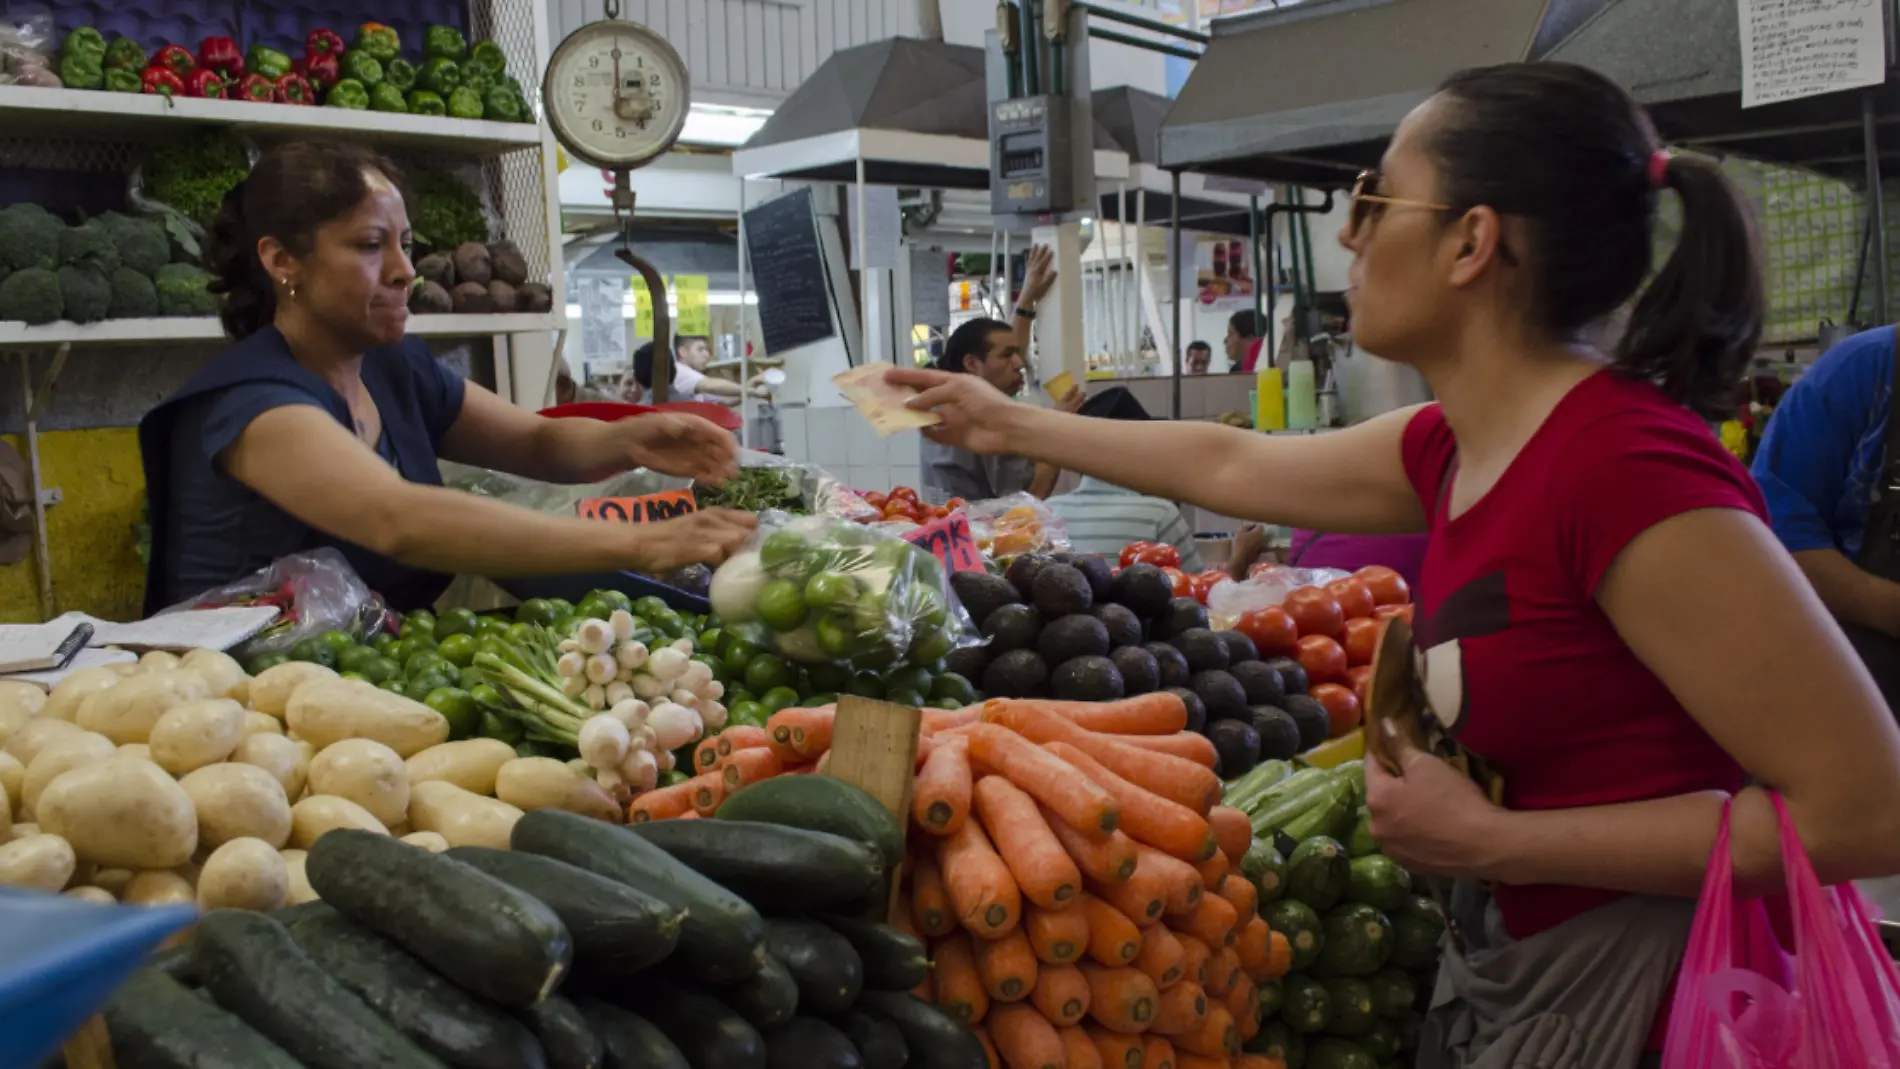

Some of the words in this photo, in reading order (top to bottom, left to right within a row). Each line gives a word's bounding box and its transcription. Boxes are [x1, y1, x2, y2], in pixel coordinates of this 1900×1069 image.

[589, 56, 599, 68] 9
[637, 56, 644, 68] 1
[574, 75, 585, 87] 8
[650, 75, 661, 87] 2
[575, 100, 585, 112] 7
[592, 119, 603, 131] 6
[615, 127, 626, 139] 5
